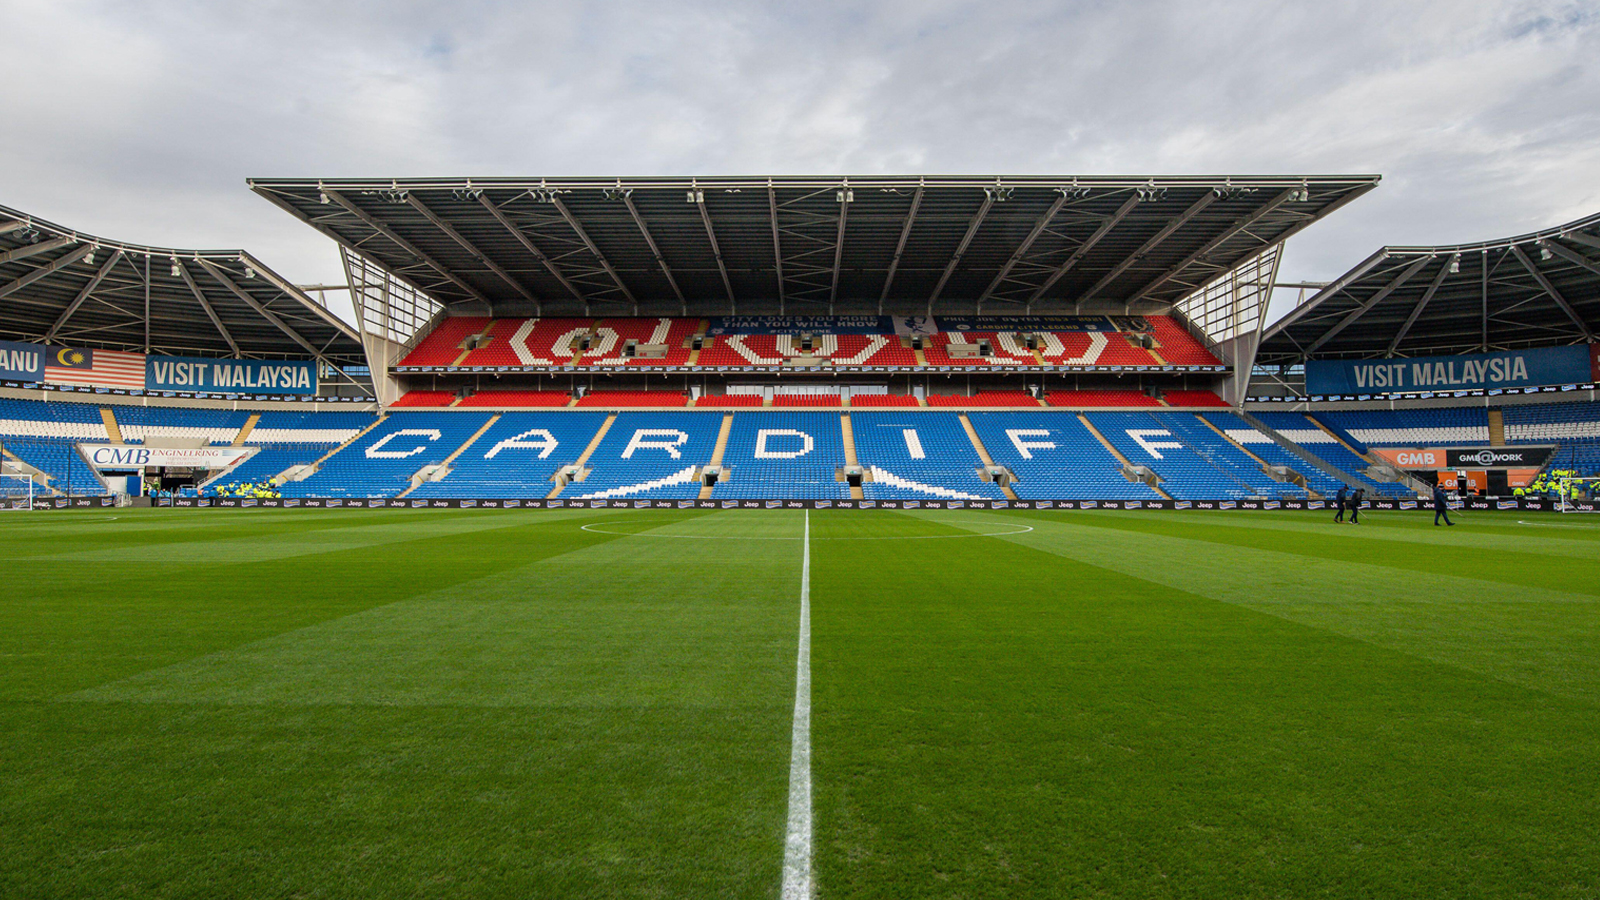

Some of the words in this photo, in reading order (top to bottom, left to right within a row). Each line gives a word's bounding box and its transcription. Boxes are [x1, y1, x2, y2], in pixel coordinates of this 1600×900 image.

[154, 361, 208, 387] VISIT
[213, 364, 311, 389] MALAYSIA
[1354, 364, 1406, 388] VISIT
[1412, 356, 1528, 386] MALAYSIA
[366, 428, 1182, 460] CARDIFF
[93, 448, 150, 465] CMB
[1397, 453, 1436, 465] GMB
[1459, 450, 1523, 465] GMB@WORK
